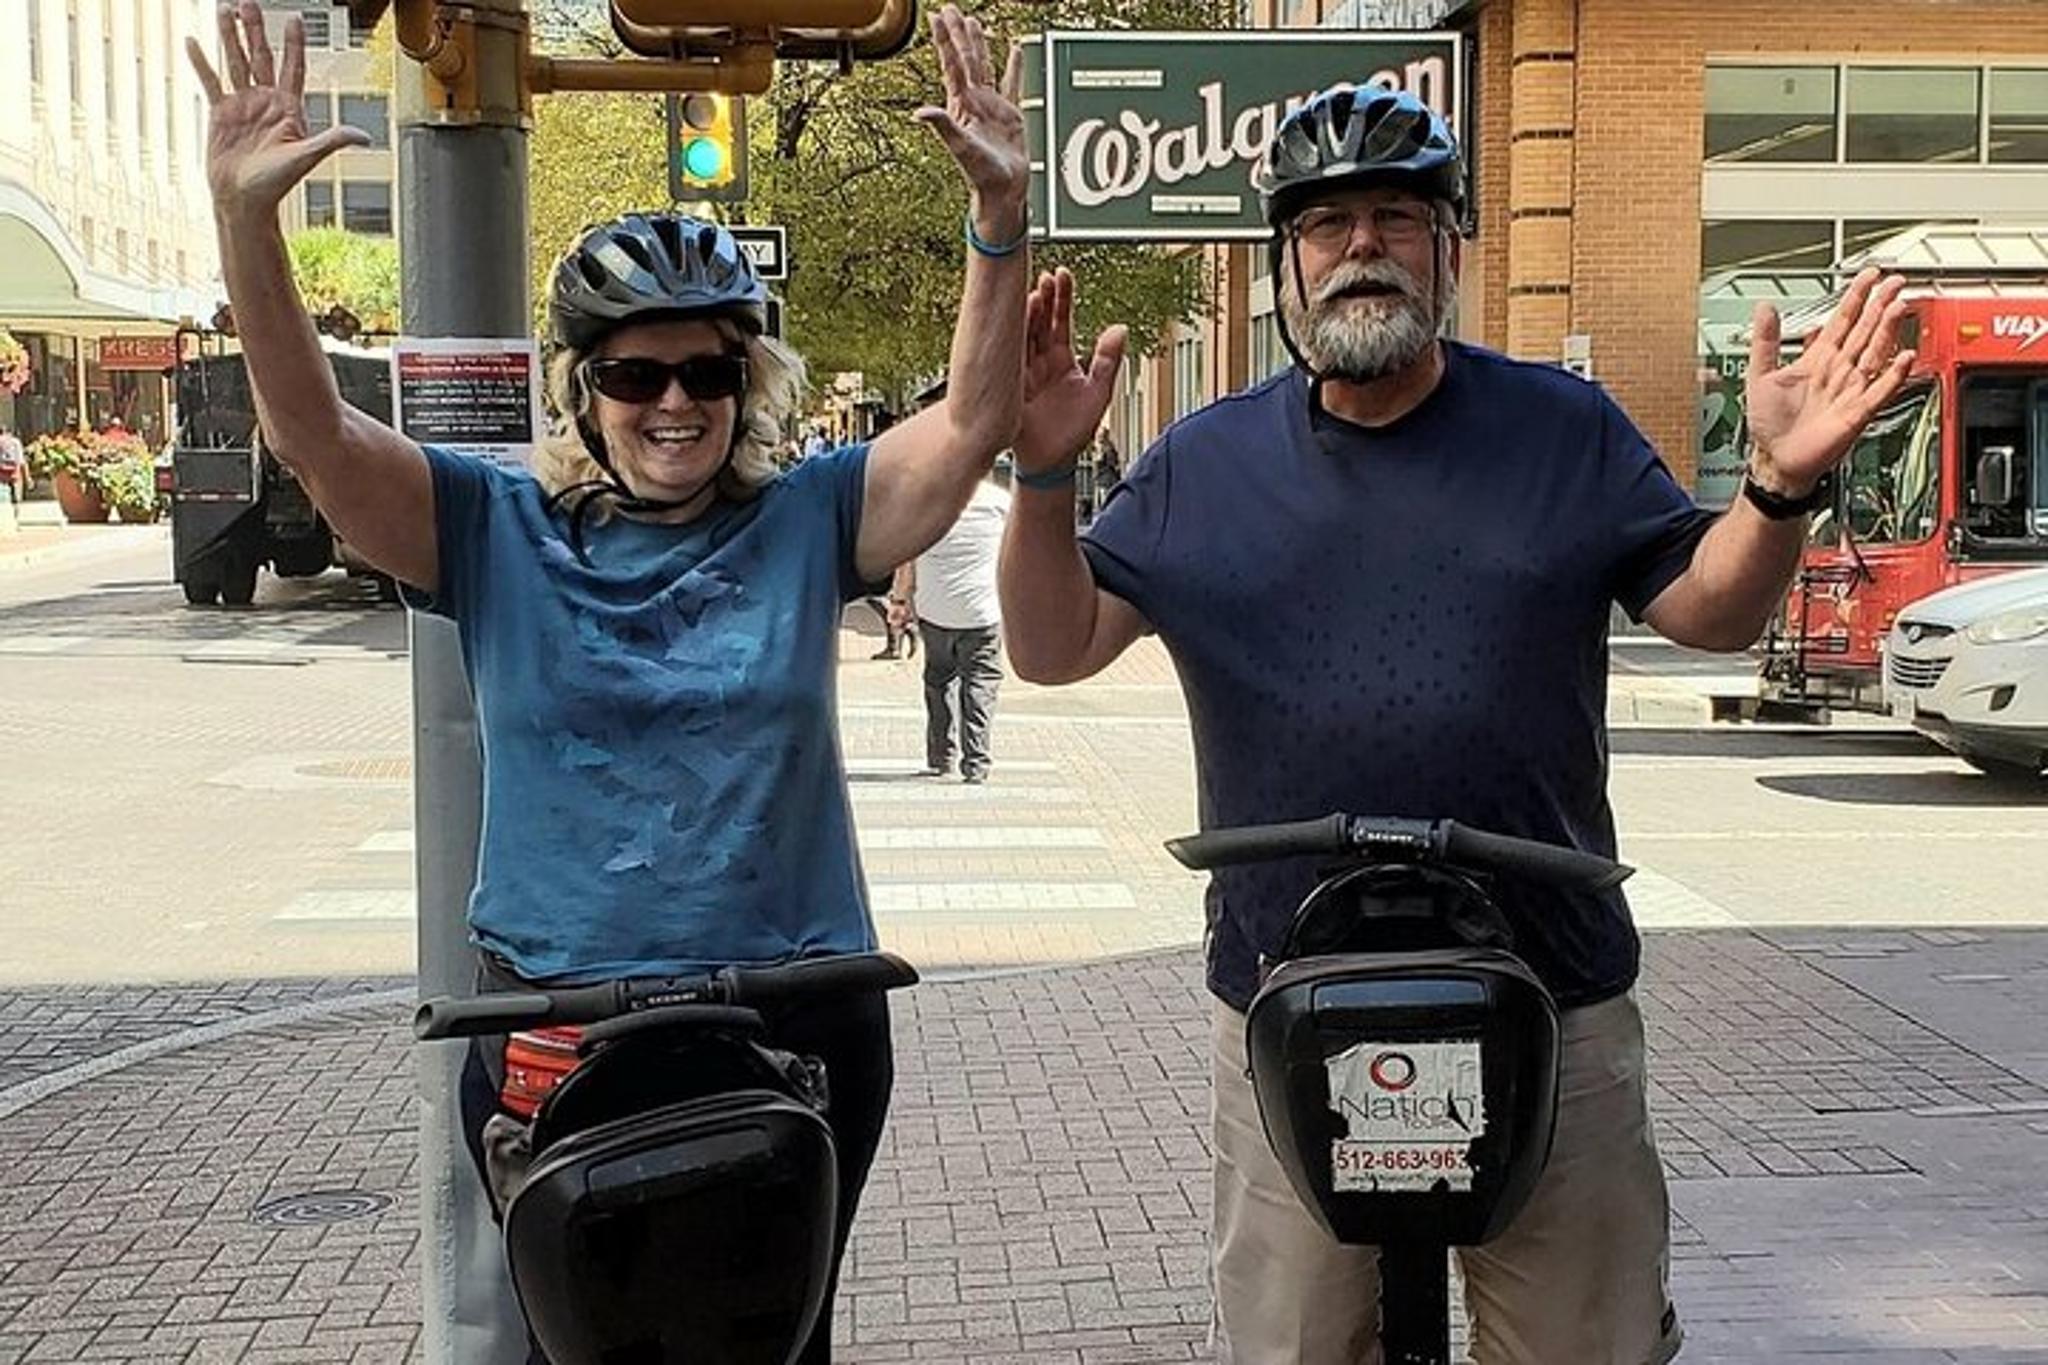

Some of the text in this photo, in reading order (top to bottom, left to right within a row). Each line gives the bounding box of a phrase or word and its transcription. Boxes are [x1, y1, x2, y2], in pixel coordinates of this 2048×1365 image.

[1061, 56, 1446, 206] Walgn
[1339, 1091, 1474, 1120] Nation
[1336, 1150, 1469, 1169] 512-663-963
